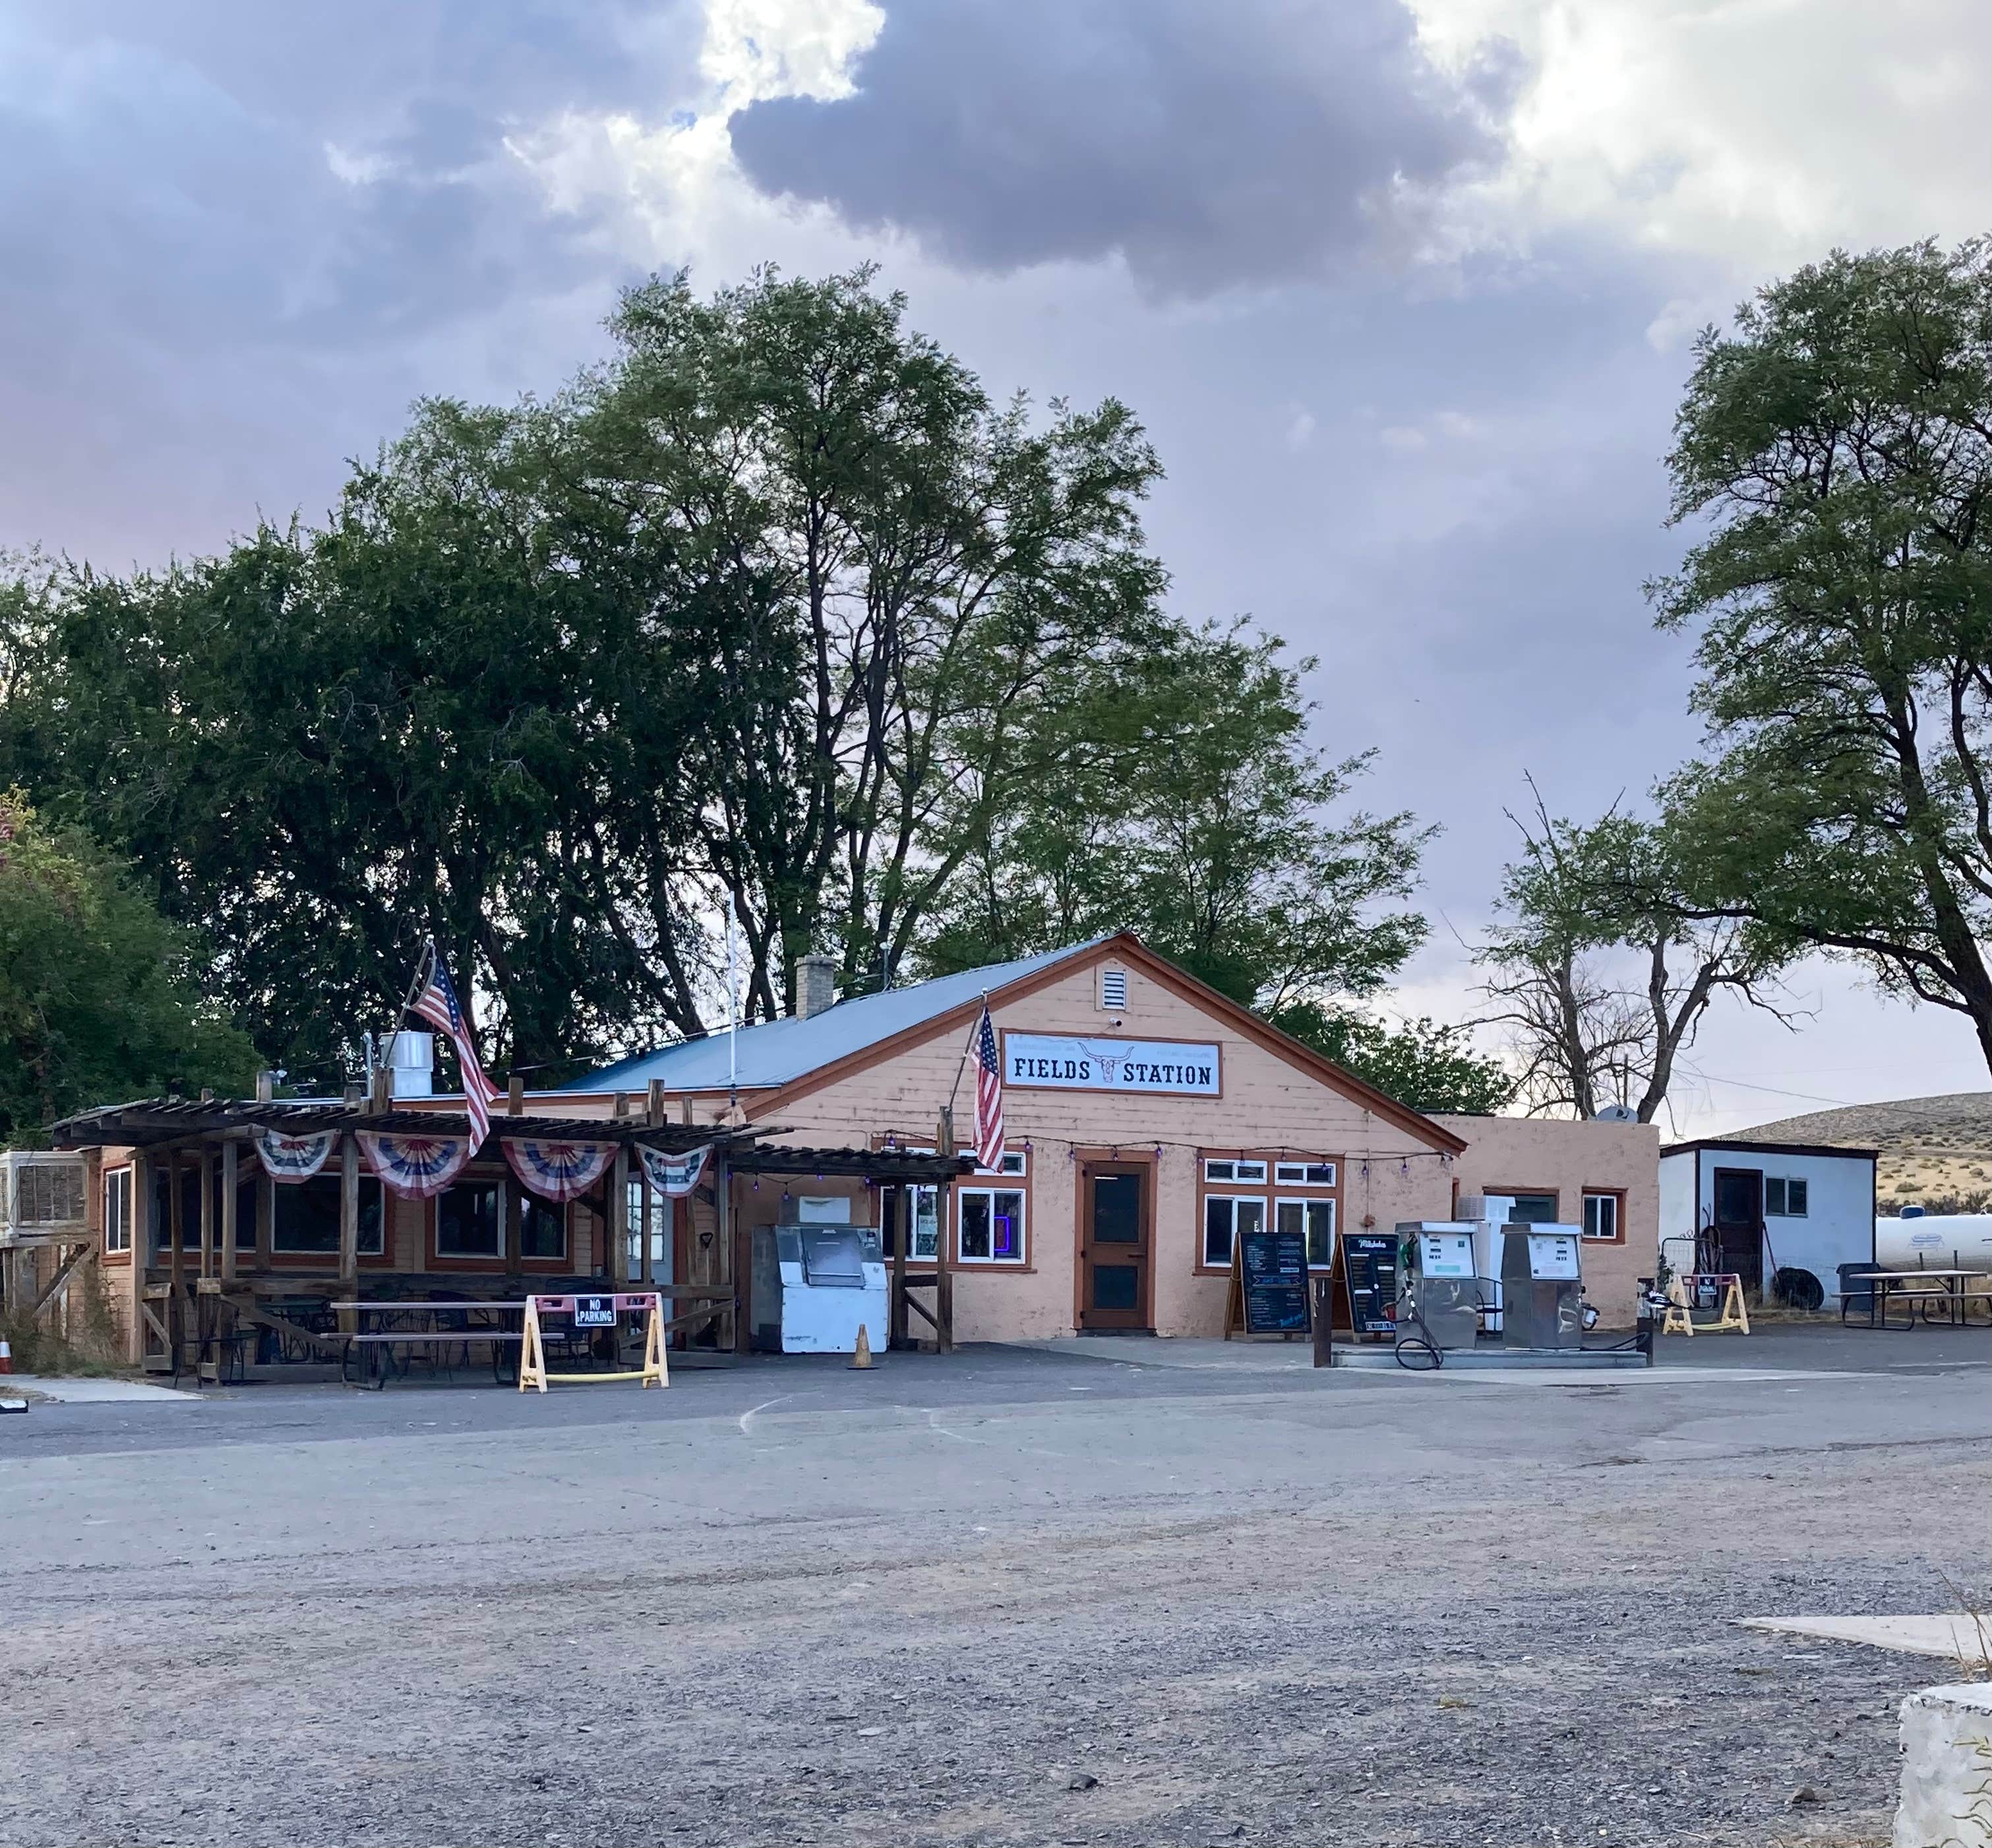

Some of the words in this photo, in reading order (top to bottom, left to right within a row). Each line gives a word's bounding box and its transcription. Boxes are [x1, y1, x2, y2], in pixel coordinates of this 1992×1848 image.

[1014, 1058, 1090, 1080] FIELDS
[1124, 1063, 1211, 1085] STATION
[589, 1299, 601, 1311] NO
[580, 1310, 613, 1323] PARKING
